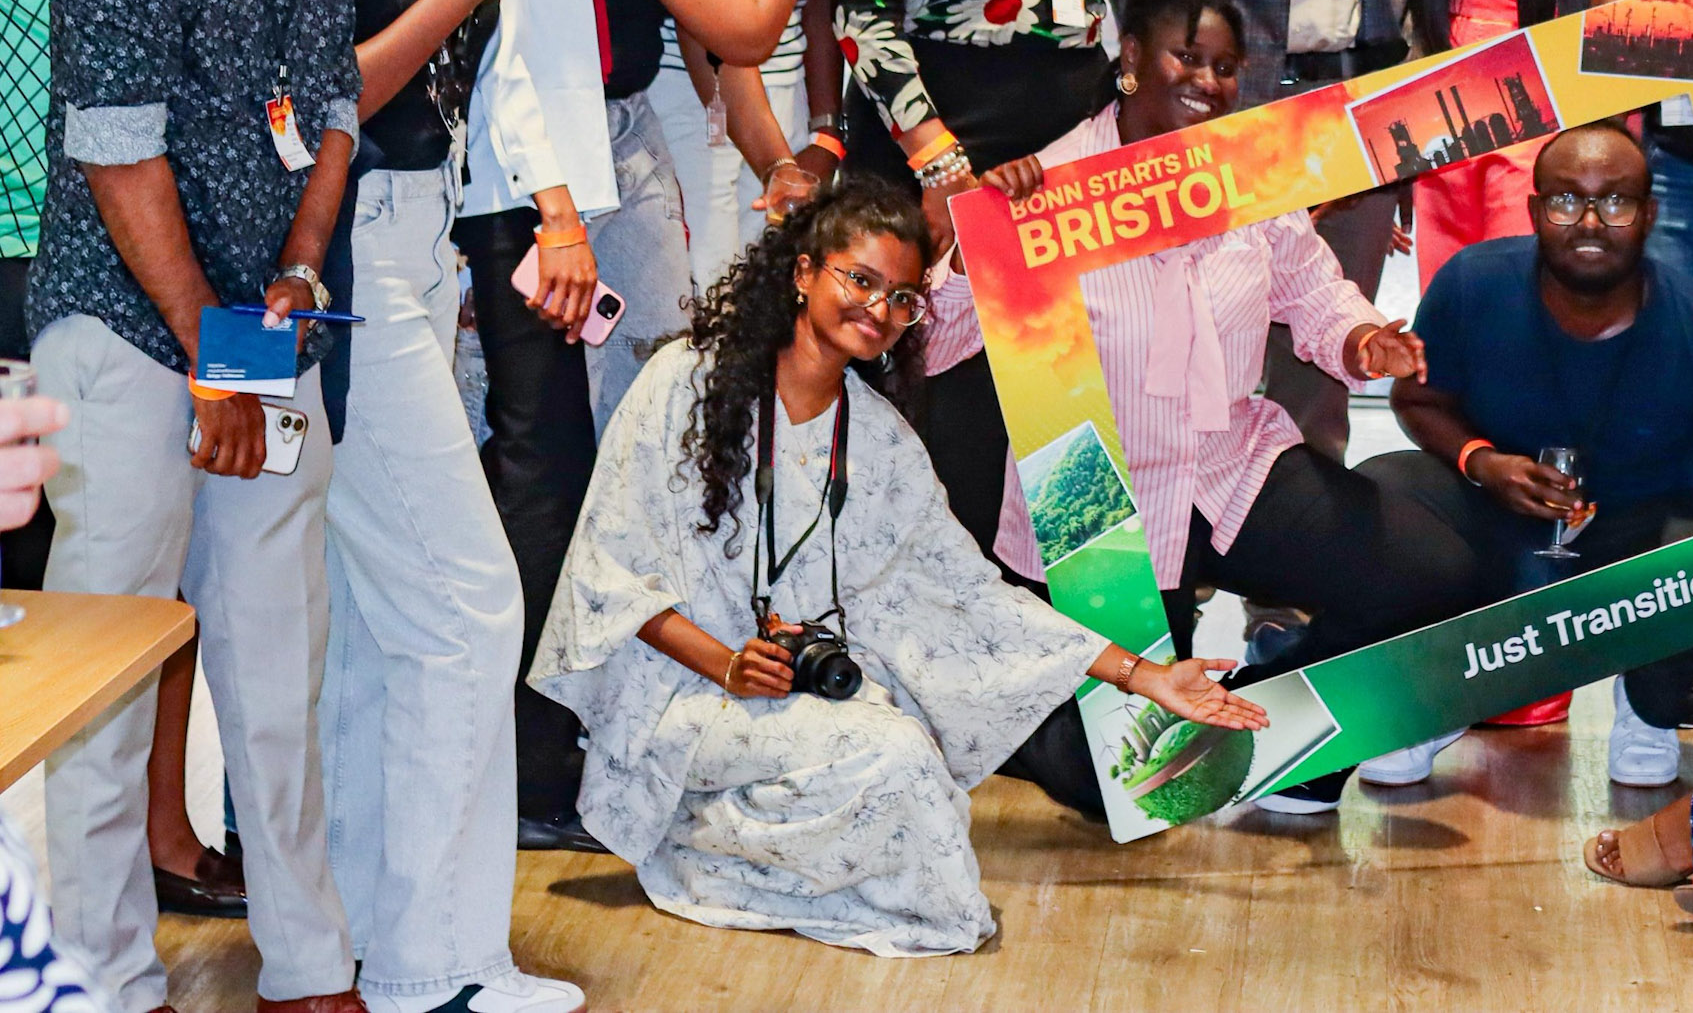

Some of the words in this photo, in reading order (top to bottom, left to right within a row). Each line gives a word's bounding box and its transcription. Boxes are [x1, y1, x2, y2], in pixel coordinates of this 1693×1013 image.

[1008, 181, 1083, 221] BONN
[1089, 153, 1181, 197] STARTS
[1186, 143, 1214, 167] IN
[1016, 163, 1256, 269] BRISTOL
[1463, 624, 1544, 680] Just
